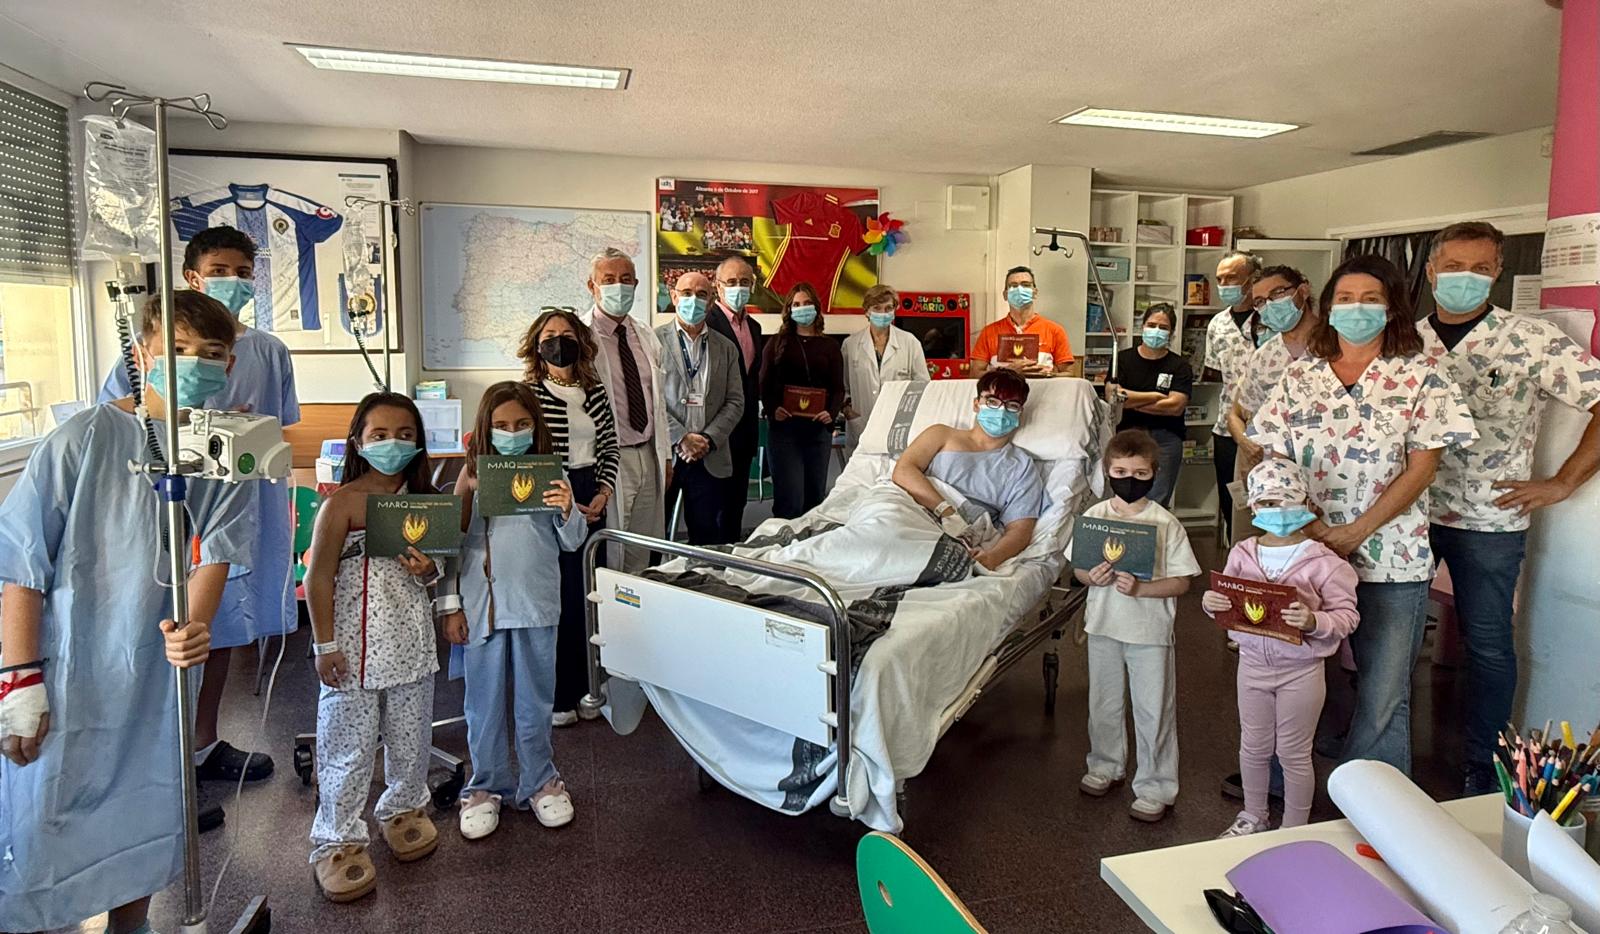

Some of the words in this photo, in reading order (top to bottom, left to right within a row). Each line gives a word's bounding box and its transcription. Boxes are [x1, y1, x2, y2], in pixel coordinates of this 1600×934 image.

[914, 302, 945, 312] MARIO
[487, 461, 516, 469] MARQ
[377, 500, 409, 509] MARQ
[1082, 522, 1109, 533] MARQ
[1217, 580, 1244, 592] MARQ
